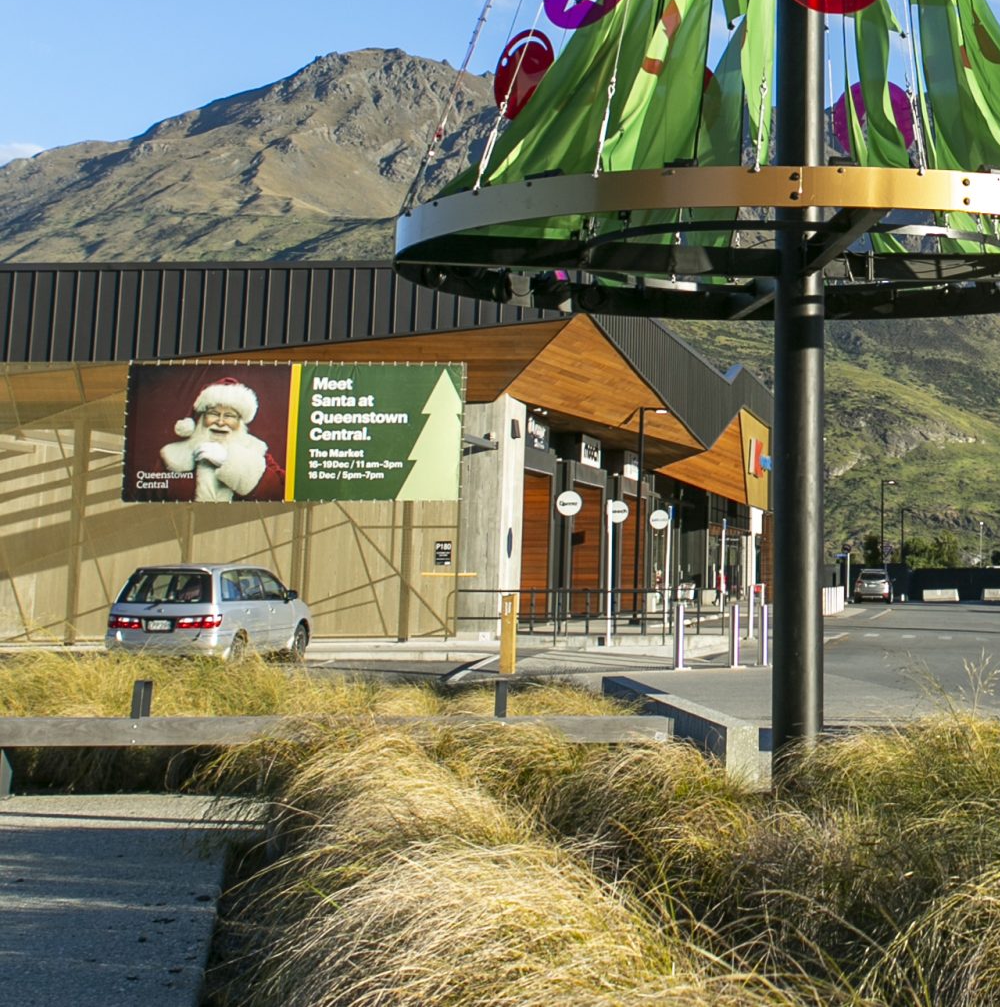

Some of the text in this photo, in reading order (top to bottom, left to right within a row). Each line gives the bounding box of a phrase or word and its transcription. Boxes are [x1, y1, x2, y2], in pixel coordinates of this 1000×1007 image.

[313, 377, 353, 390] Meet
[311, 394, 374, 407] Santa at
[310, 410, 408, 425] Queenstown
[309, 427, 371, 441] Central.
[309, 449, 364, 458] The Market
[136, 470, 194, 480] Queenstown
[318, 471, 336, 479] Dec
[136, 480, 169, 489] Central
